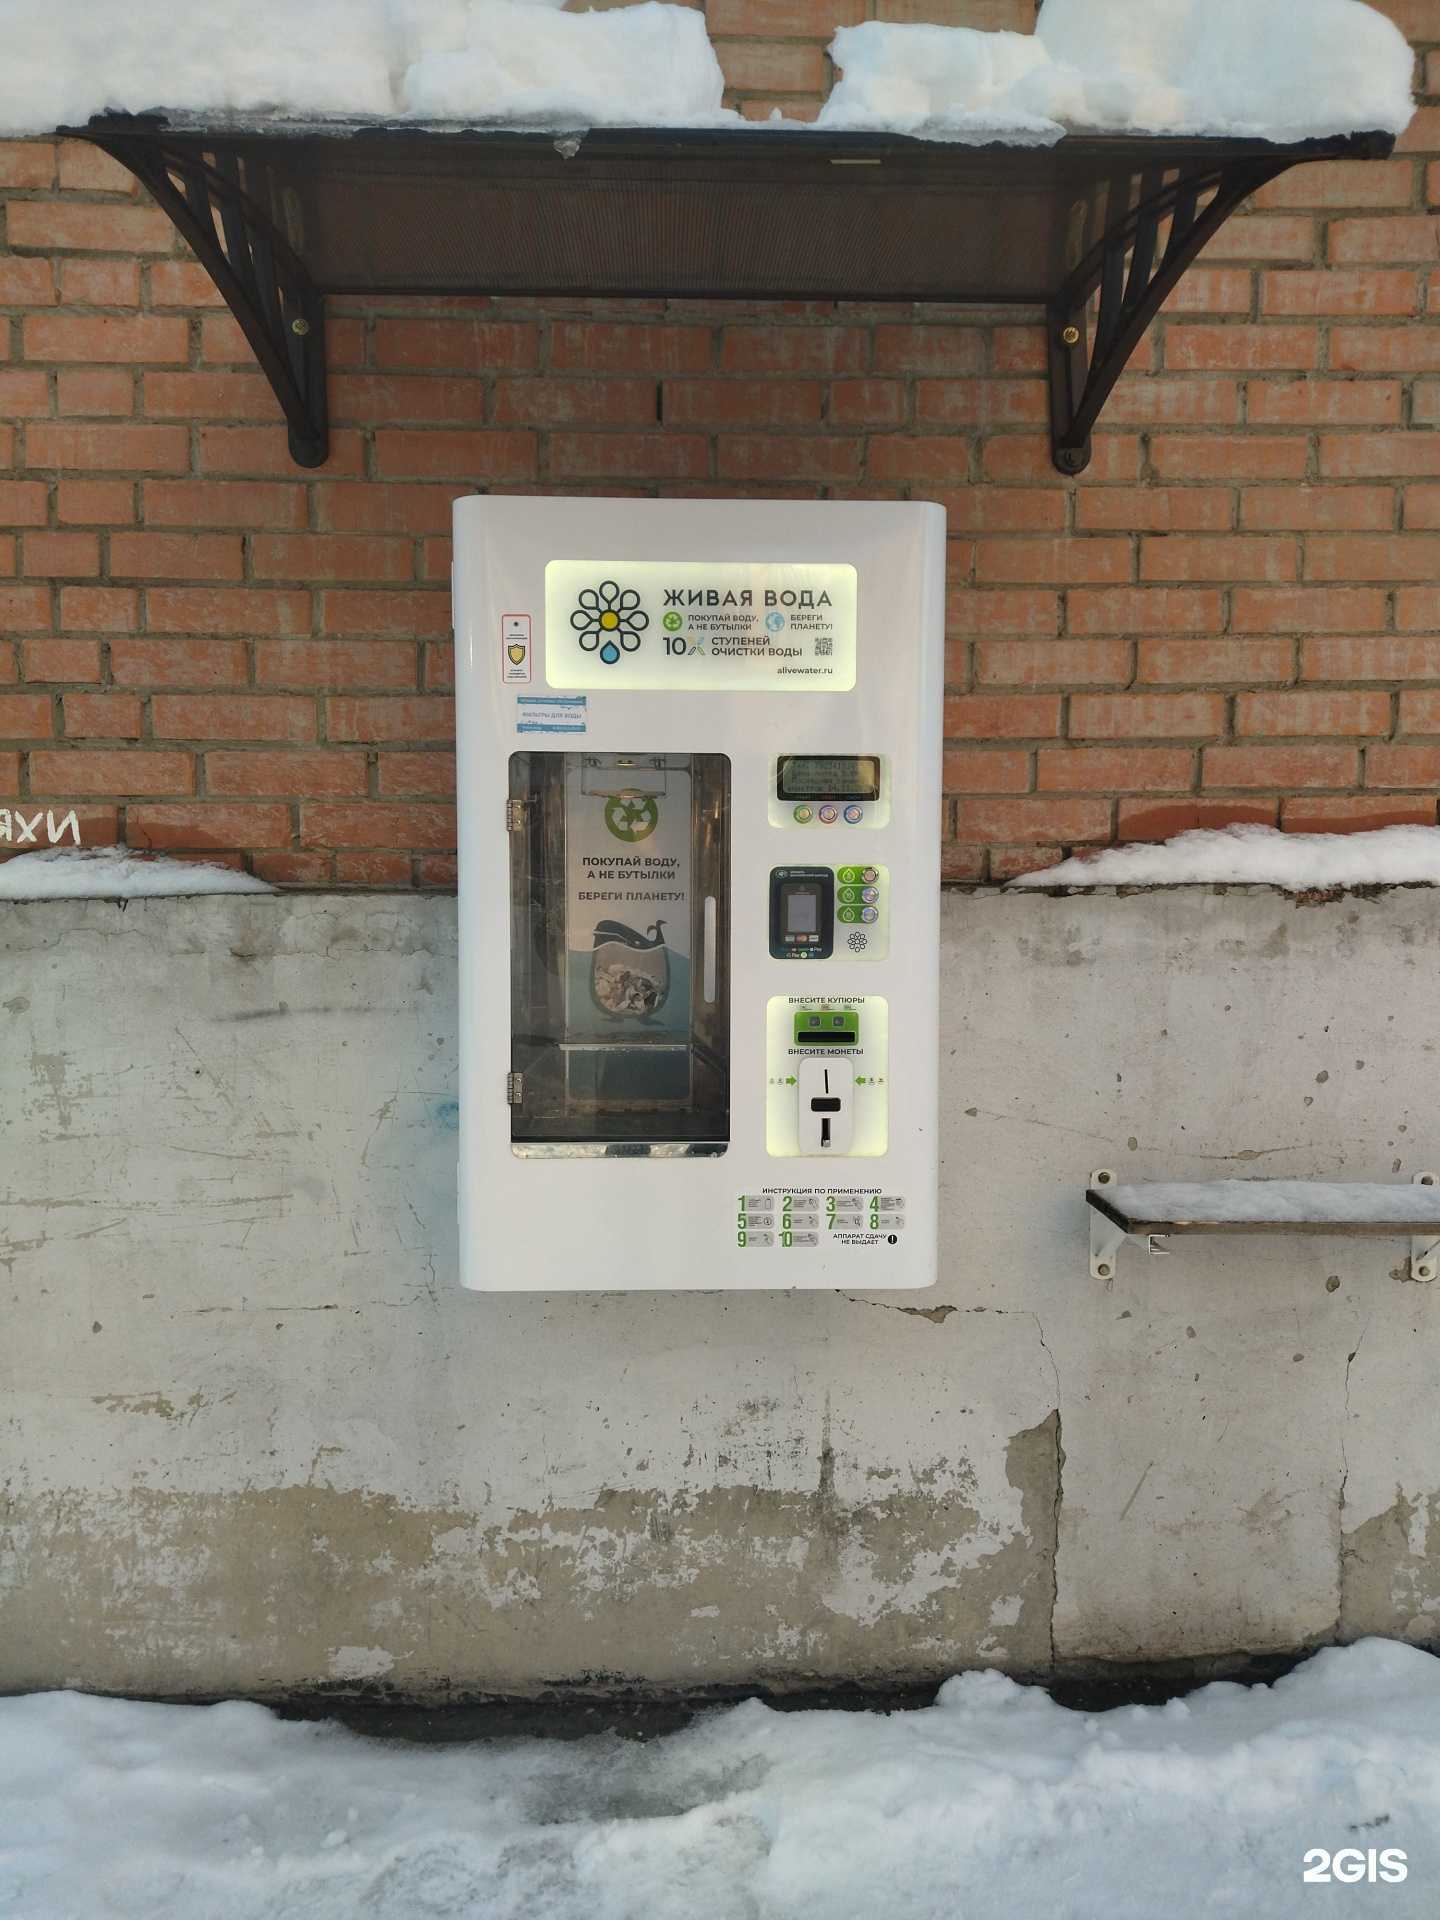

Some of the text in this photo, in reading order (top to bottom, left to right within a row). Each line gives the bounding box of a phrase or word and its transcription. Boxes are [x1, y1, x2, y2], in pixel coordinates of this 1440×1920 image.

[663, 589, 832, 609] ЖИВАЯ ВОДА
[688, 614, 759, 623] ПОКУПАЙ ВОДУ,
[790, 614, 823, 622] БЕРЕГИ
[688, 623, 752, 631] А НЕ БУТЫЛКИ
[790, 623, 833, 631] ПЛАНЕТУ!
[663, 636, 687, 656] 10
[711, 636, 770, 646] СТУПЕНЕЙ
[711, 647, 803, 657] ОЧИСТКИ ВОДЫ
[582, 856, 680, 868] ПОКУПАЙ ВОДУ,
[587, 870, 676, 879] А НЕ БУТЫЛКИ
[578, 892, 685, 901] БЕРЕГИ ПЛАНЕТУ!
[738, 1195, 745, 1212] 1
[782, 1195, 792, 1212] 2
[826, 1195, 836, 1212] 3
[869, 1195, 879, 1212] 4
[737, 1213, 747, 1229] 5
[782, 1213, 792, 1229] 6
[826, 1213, 836, 1229] 7
[870, 1213, 879, 1229] 8
[737, 1231, 746, 1247] 9
[778, 1231, 792, 1247] 10
